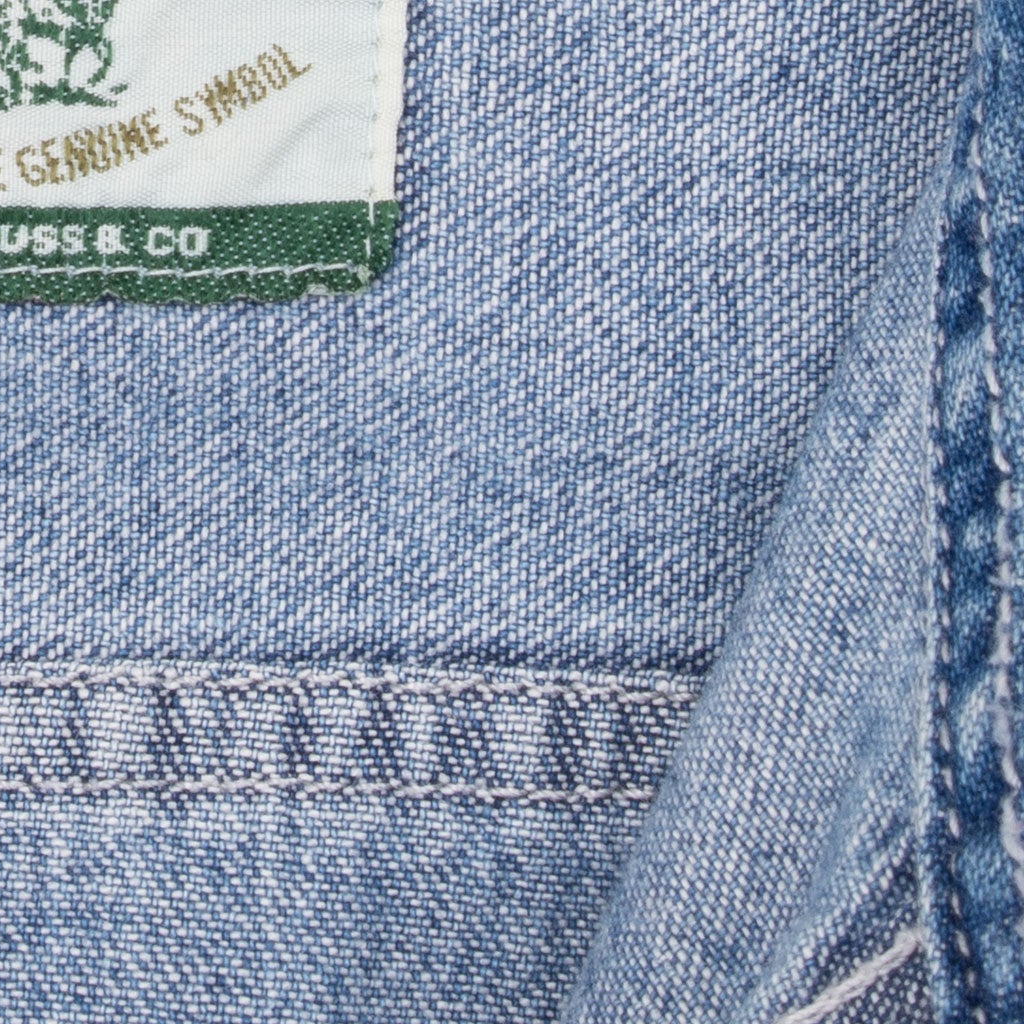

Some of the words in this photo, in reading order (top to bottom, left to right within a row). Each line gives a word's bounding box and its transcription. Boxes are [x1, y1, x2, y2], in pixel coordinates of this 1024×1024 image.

[15, 108, 168, 187] GENUINE
[174, 44, 313, 138] SYMBOL
[95, 224, 126, 255] &
[147, 224, 212, 257] CO
